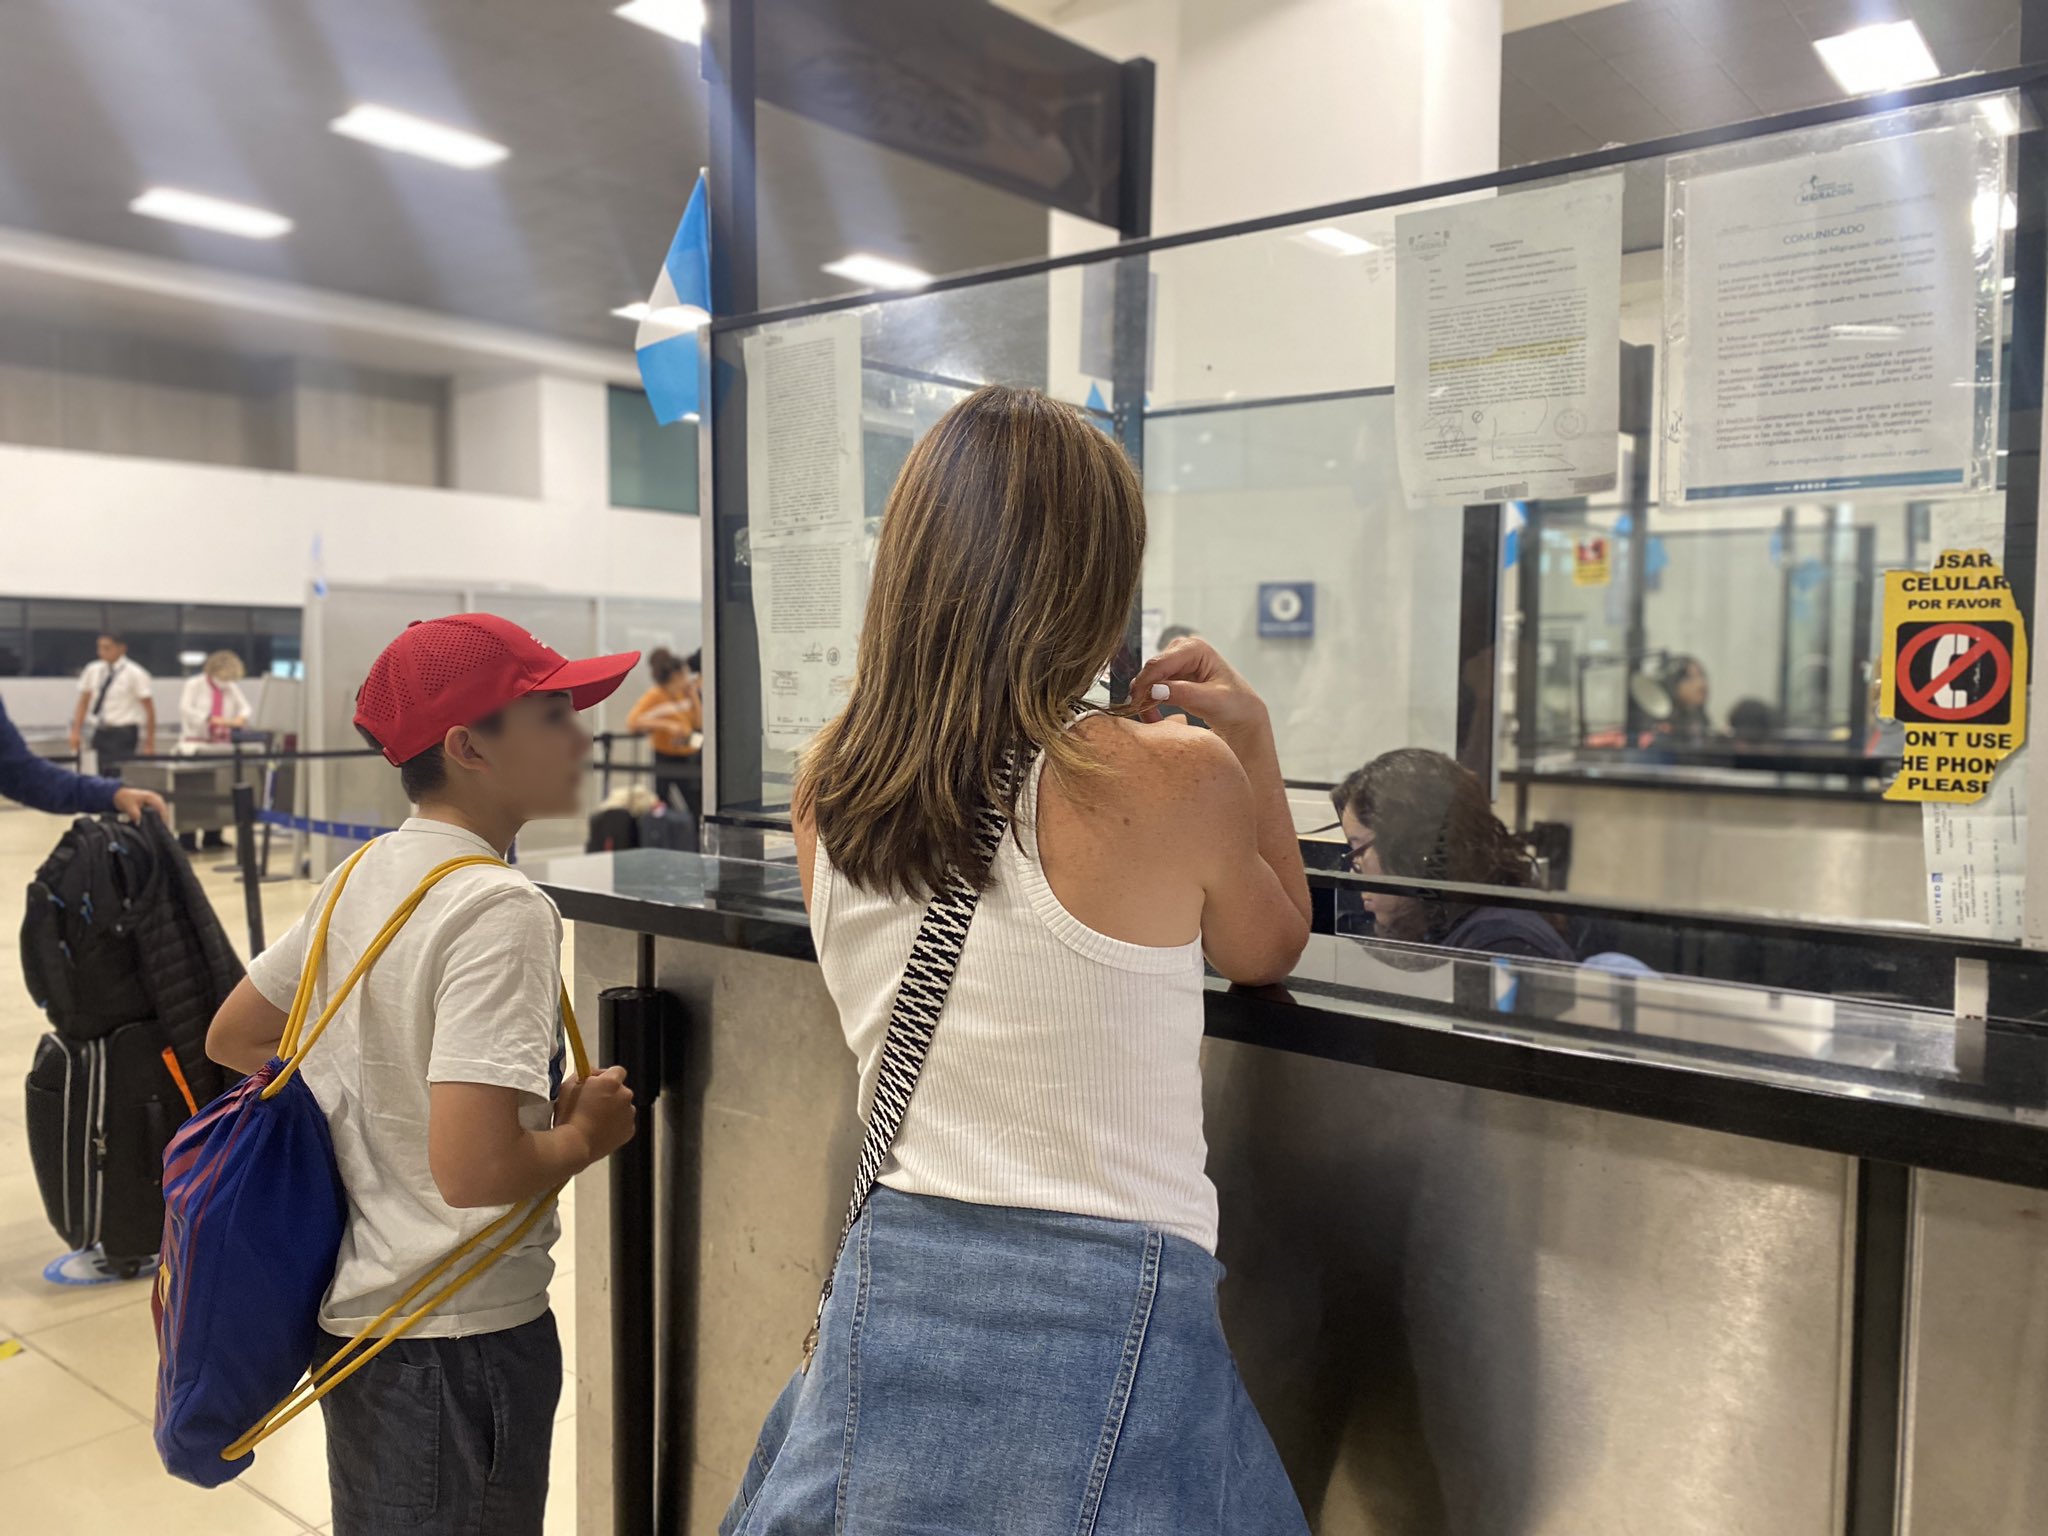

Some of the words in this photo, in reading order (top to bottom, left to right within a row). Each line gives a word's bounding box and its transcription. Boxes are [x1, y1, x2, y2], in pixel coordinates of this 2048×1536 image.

[1783, 223, 1865, 245] COMUNICADO
[1902, 576, 2010, 592] CELULAR
[1908, 599, 1941, 610] POR
[1947, 598, 2002, 610] FAVOR
[1967, 732, 2012, 749] USE
[1901, 756, 1928, 771] HE
[1936, 757, 1998, 774] PHON
[1934, 884, 1944, 924] UNITED
